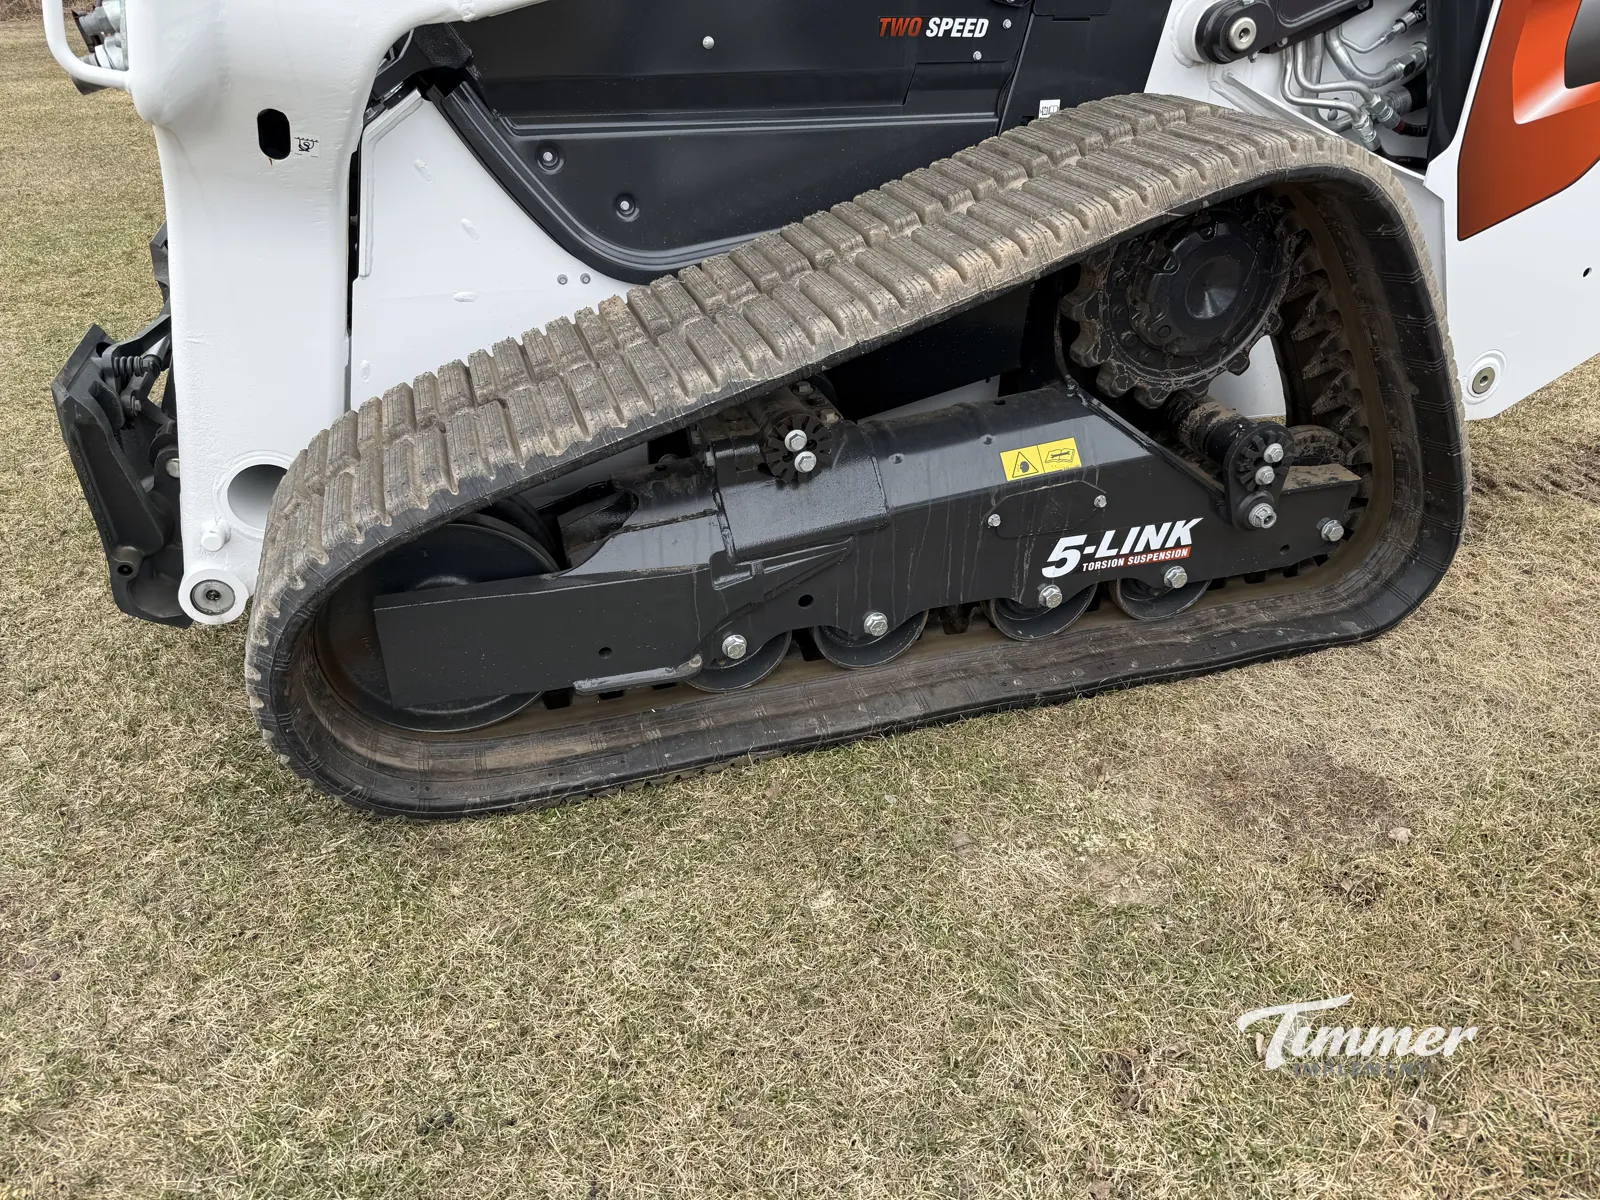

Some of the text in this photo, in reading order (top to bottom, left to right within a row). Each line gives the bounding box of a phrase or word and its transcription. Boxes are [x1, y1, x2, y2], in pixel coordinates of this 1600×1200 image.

[879, 17, 990, 38] TWO SPEED
[1041, 517, 1204, 578] 5-LINK
[1082, 548, 1188, 571] TORSION SUSPENSION
